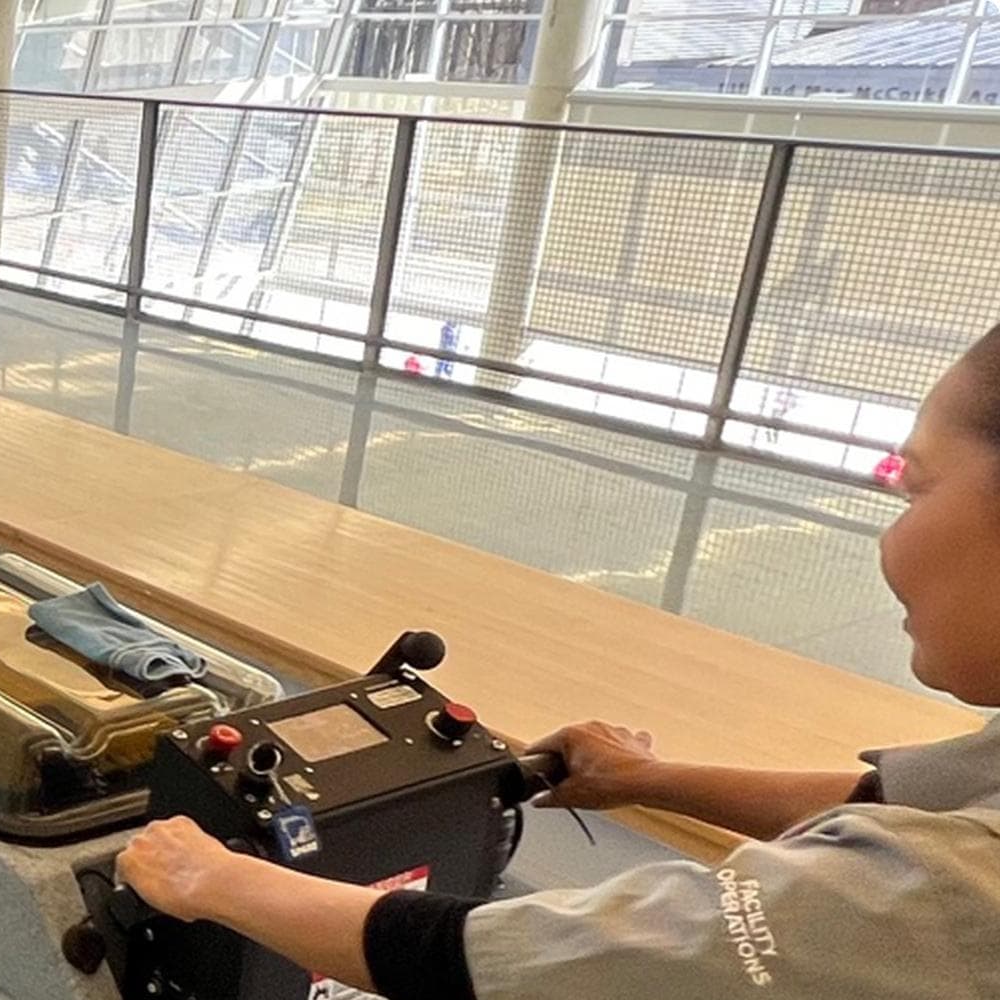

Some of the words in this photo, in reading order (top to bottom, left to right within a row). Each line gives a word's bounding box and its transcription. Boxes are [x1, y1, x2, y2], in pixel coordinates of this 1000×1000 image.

[855, 86, 947, 102] McCorkl
[716, 868, 772, 986] OPERATIONS
[739, 879, 777, 956] FACILITY
